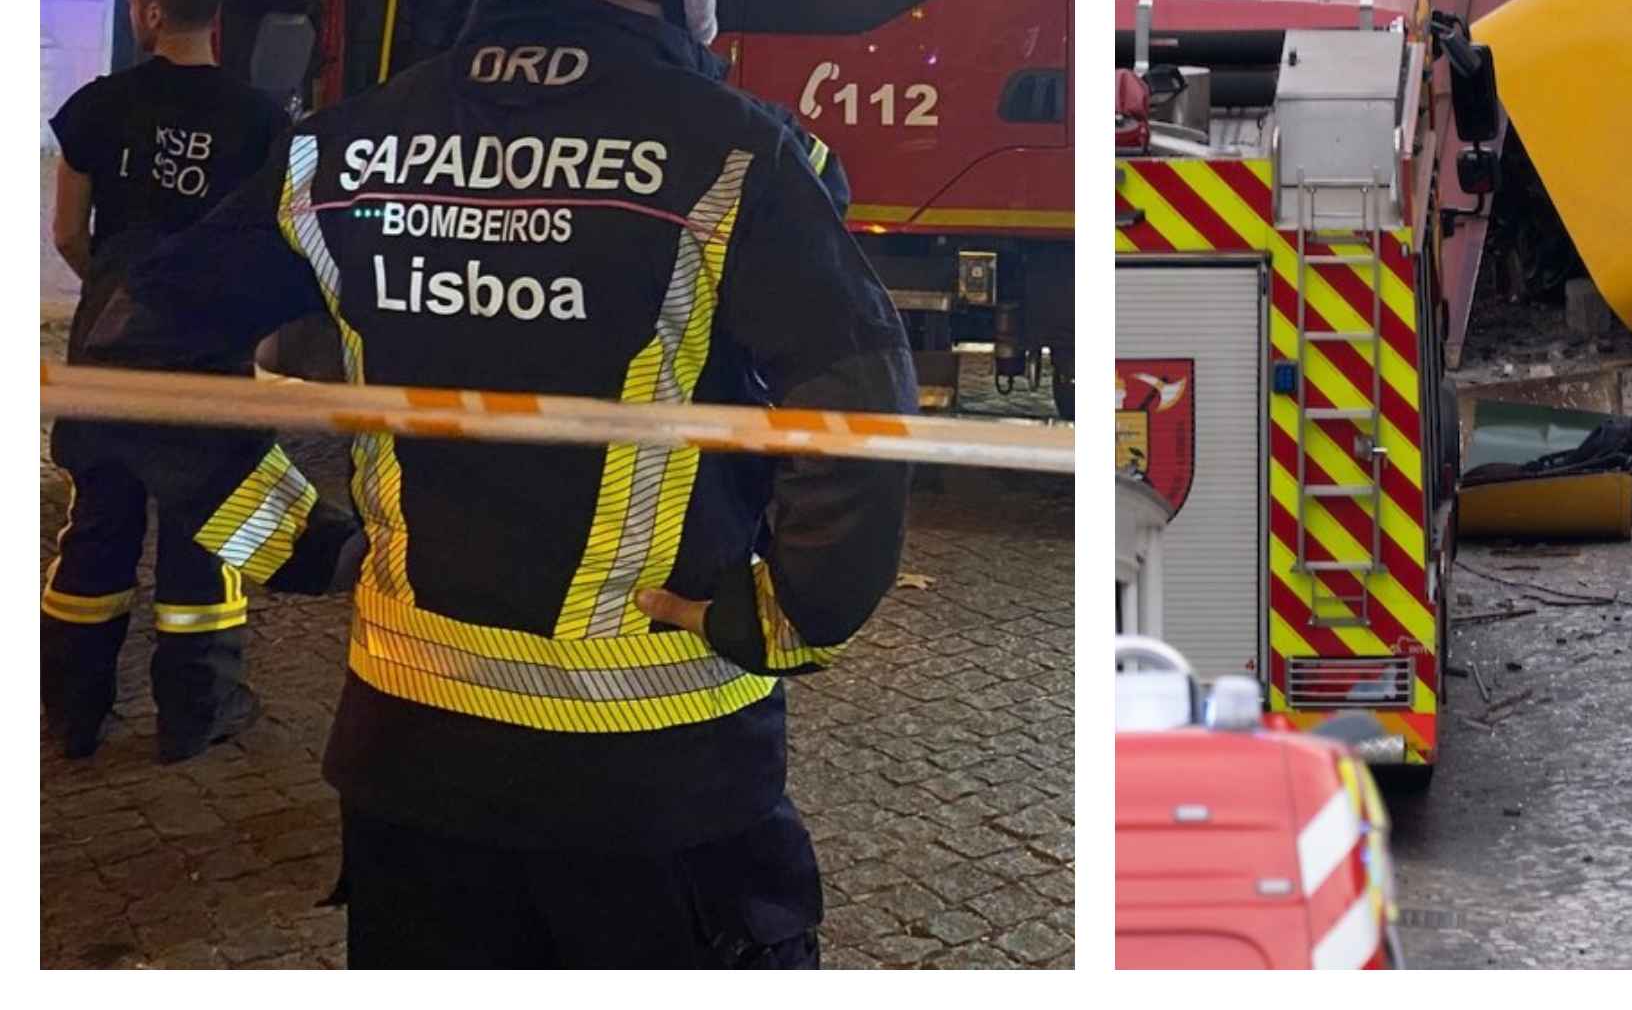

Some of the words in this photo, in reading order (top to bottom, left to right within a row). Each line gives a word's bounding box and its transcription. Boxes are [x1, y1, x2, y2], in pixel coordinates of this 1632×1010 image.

[469, 45, 589, 86] ORD
[833, 83, 939, 126] 112
[339, 134, 668, 195] SAPADORES
[382, 202, 573, 244] BOMBEIROS
[373, 254, 587, 321] Lisboa
